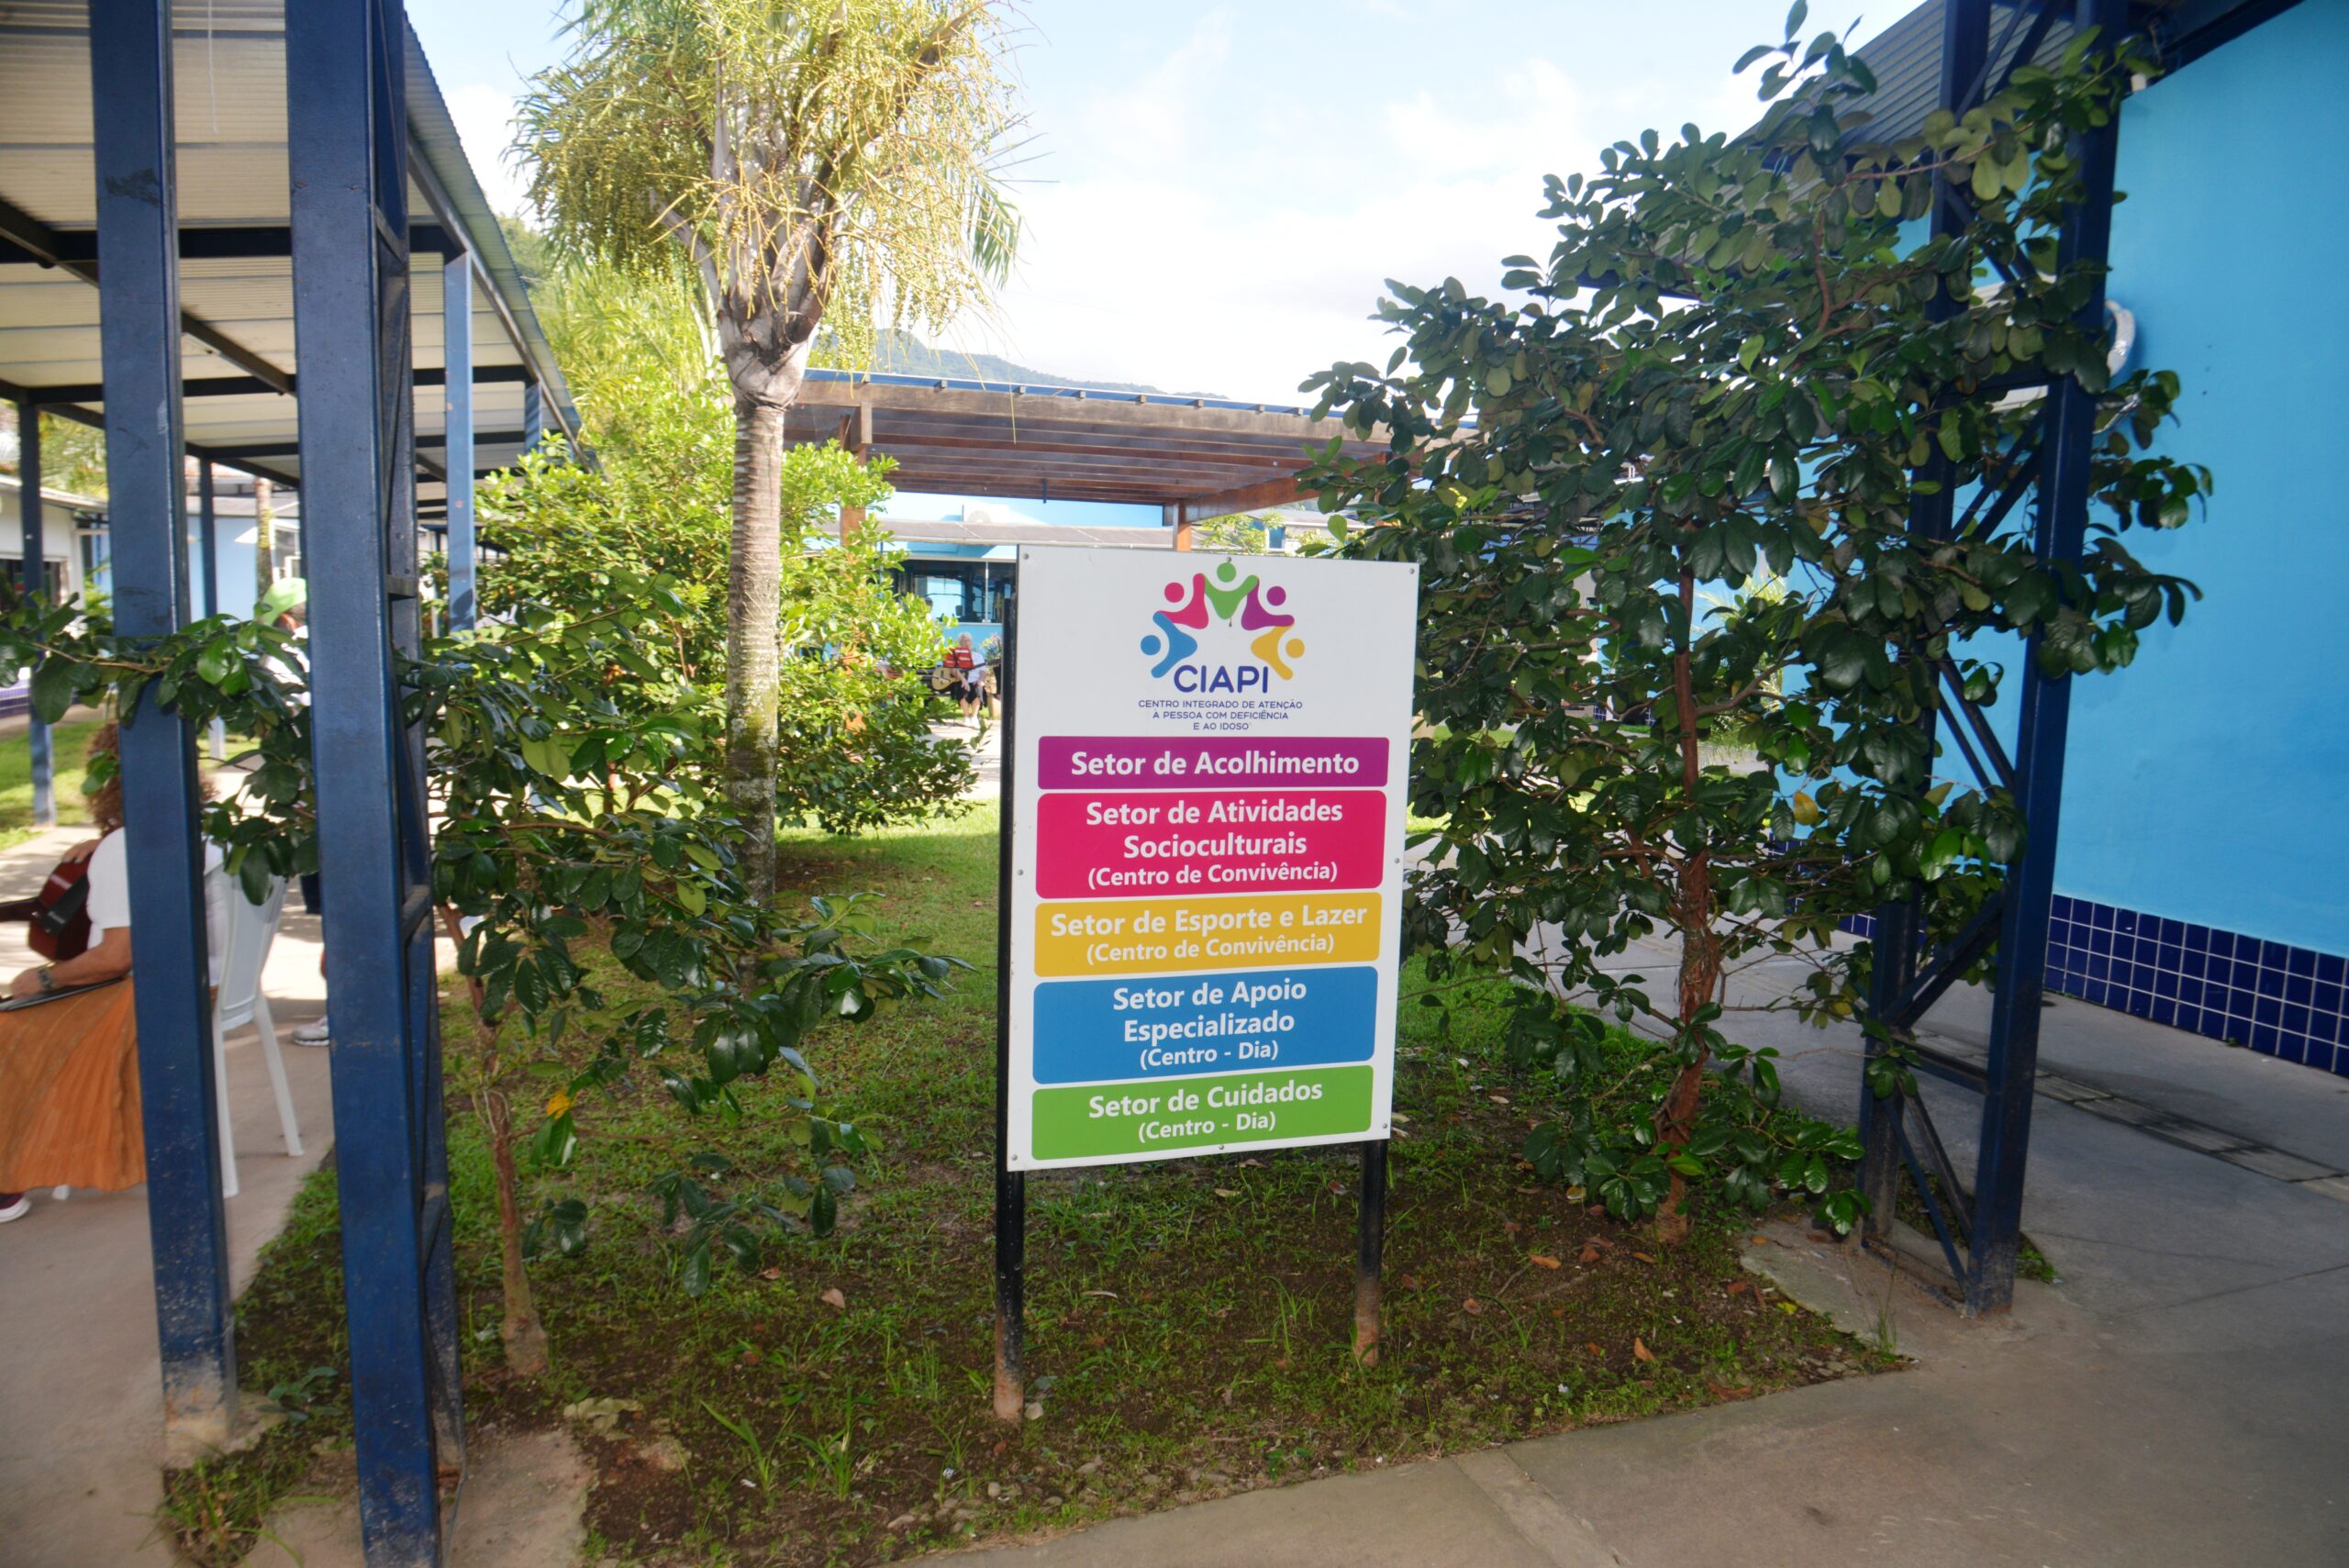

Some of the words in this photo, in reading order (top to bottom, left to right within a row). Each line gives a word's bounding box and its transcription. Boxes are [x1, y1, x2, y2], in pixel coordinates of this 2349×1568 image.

[1174, 664, 1269, 694] CIAPI
[1138, 699, 1180, 708] CENTRO
[1182, 700, 1239, 709] INTEGRADO
[1241, 700, 1255, 709] DE
[1258, 698, 1303, 710] ATENÇÃO
[1163, 710, 1203, 719] PESSOA
[1205, 711, 1228, 719] COM
[1230, 709, 1289, 720] DEFICIÊNCIA
[1193, 722, 1200, 730] E
[1202, 722, 1217, 730] AO
[1219, 722, 1250, 730] IDOSO
[1071, 751, 1146, 775] Setor
[1153, 751, 1187, 775] de
[1194, 750, 1360, 774] Acolhimento
[1086, 801, 1161, 826] Setor
[1167, 799, 1200, 824] de
[1207, 797, 1343, 823] Atividades
[1123, 830, 1308, 859] Socioculturais
[1087, 867, 1170, 890] (Centro
[1175, 864, 1202, 884] de
[1208, 861, 1338, 883] Convivência)
[1051, 913, 1126, 937] Setor
[1132, 909, 1166, 934] de
[1174, 908, 1273, 938] Esporte
[1279, 910, 1295, 928] e
[1302, 905, 1368, 926] Lazer
[1086, 942, 1168, 966] (Centro
[1174, 939, 1200, 959] de
[1207, 933, 1335, 957] Convivência)
[1114, 987, 1185, 1011] Setor
[1191, 982, 1224, 1006] de
[1230, 977, 1307, 1008] Apoio
[1124, 1009, 1295, 1046] Especializado
[1140, 1047, 1218, 1071] (Centro
[1238, 1040, 1278, 1061] Dia)
[1088, 1095, 1161, 1118] Setor
[1167, 1088, 1200, 1112] de
[1207, 1079, 1323, 1108] Cuidados
[1138, 1119, 1216, 1143] (Centro
[1236, 1111, 1276, 1131] Dia)
